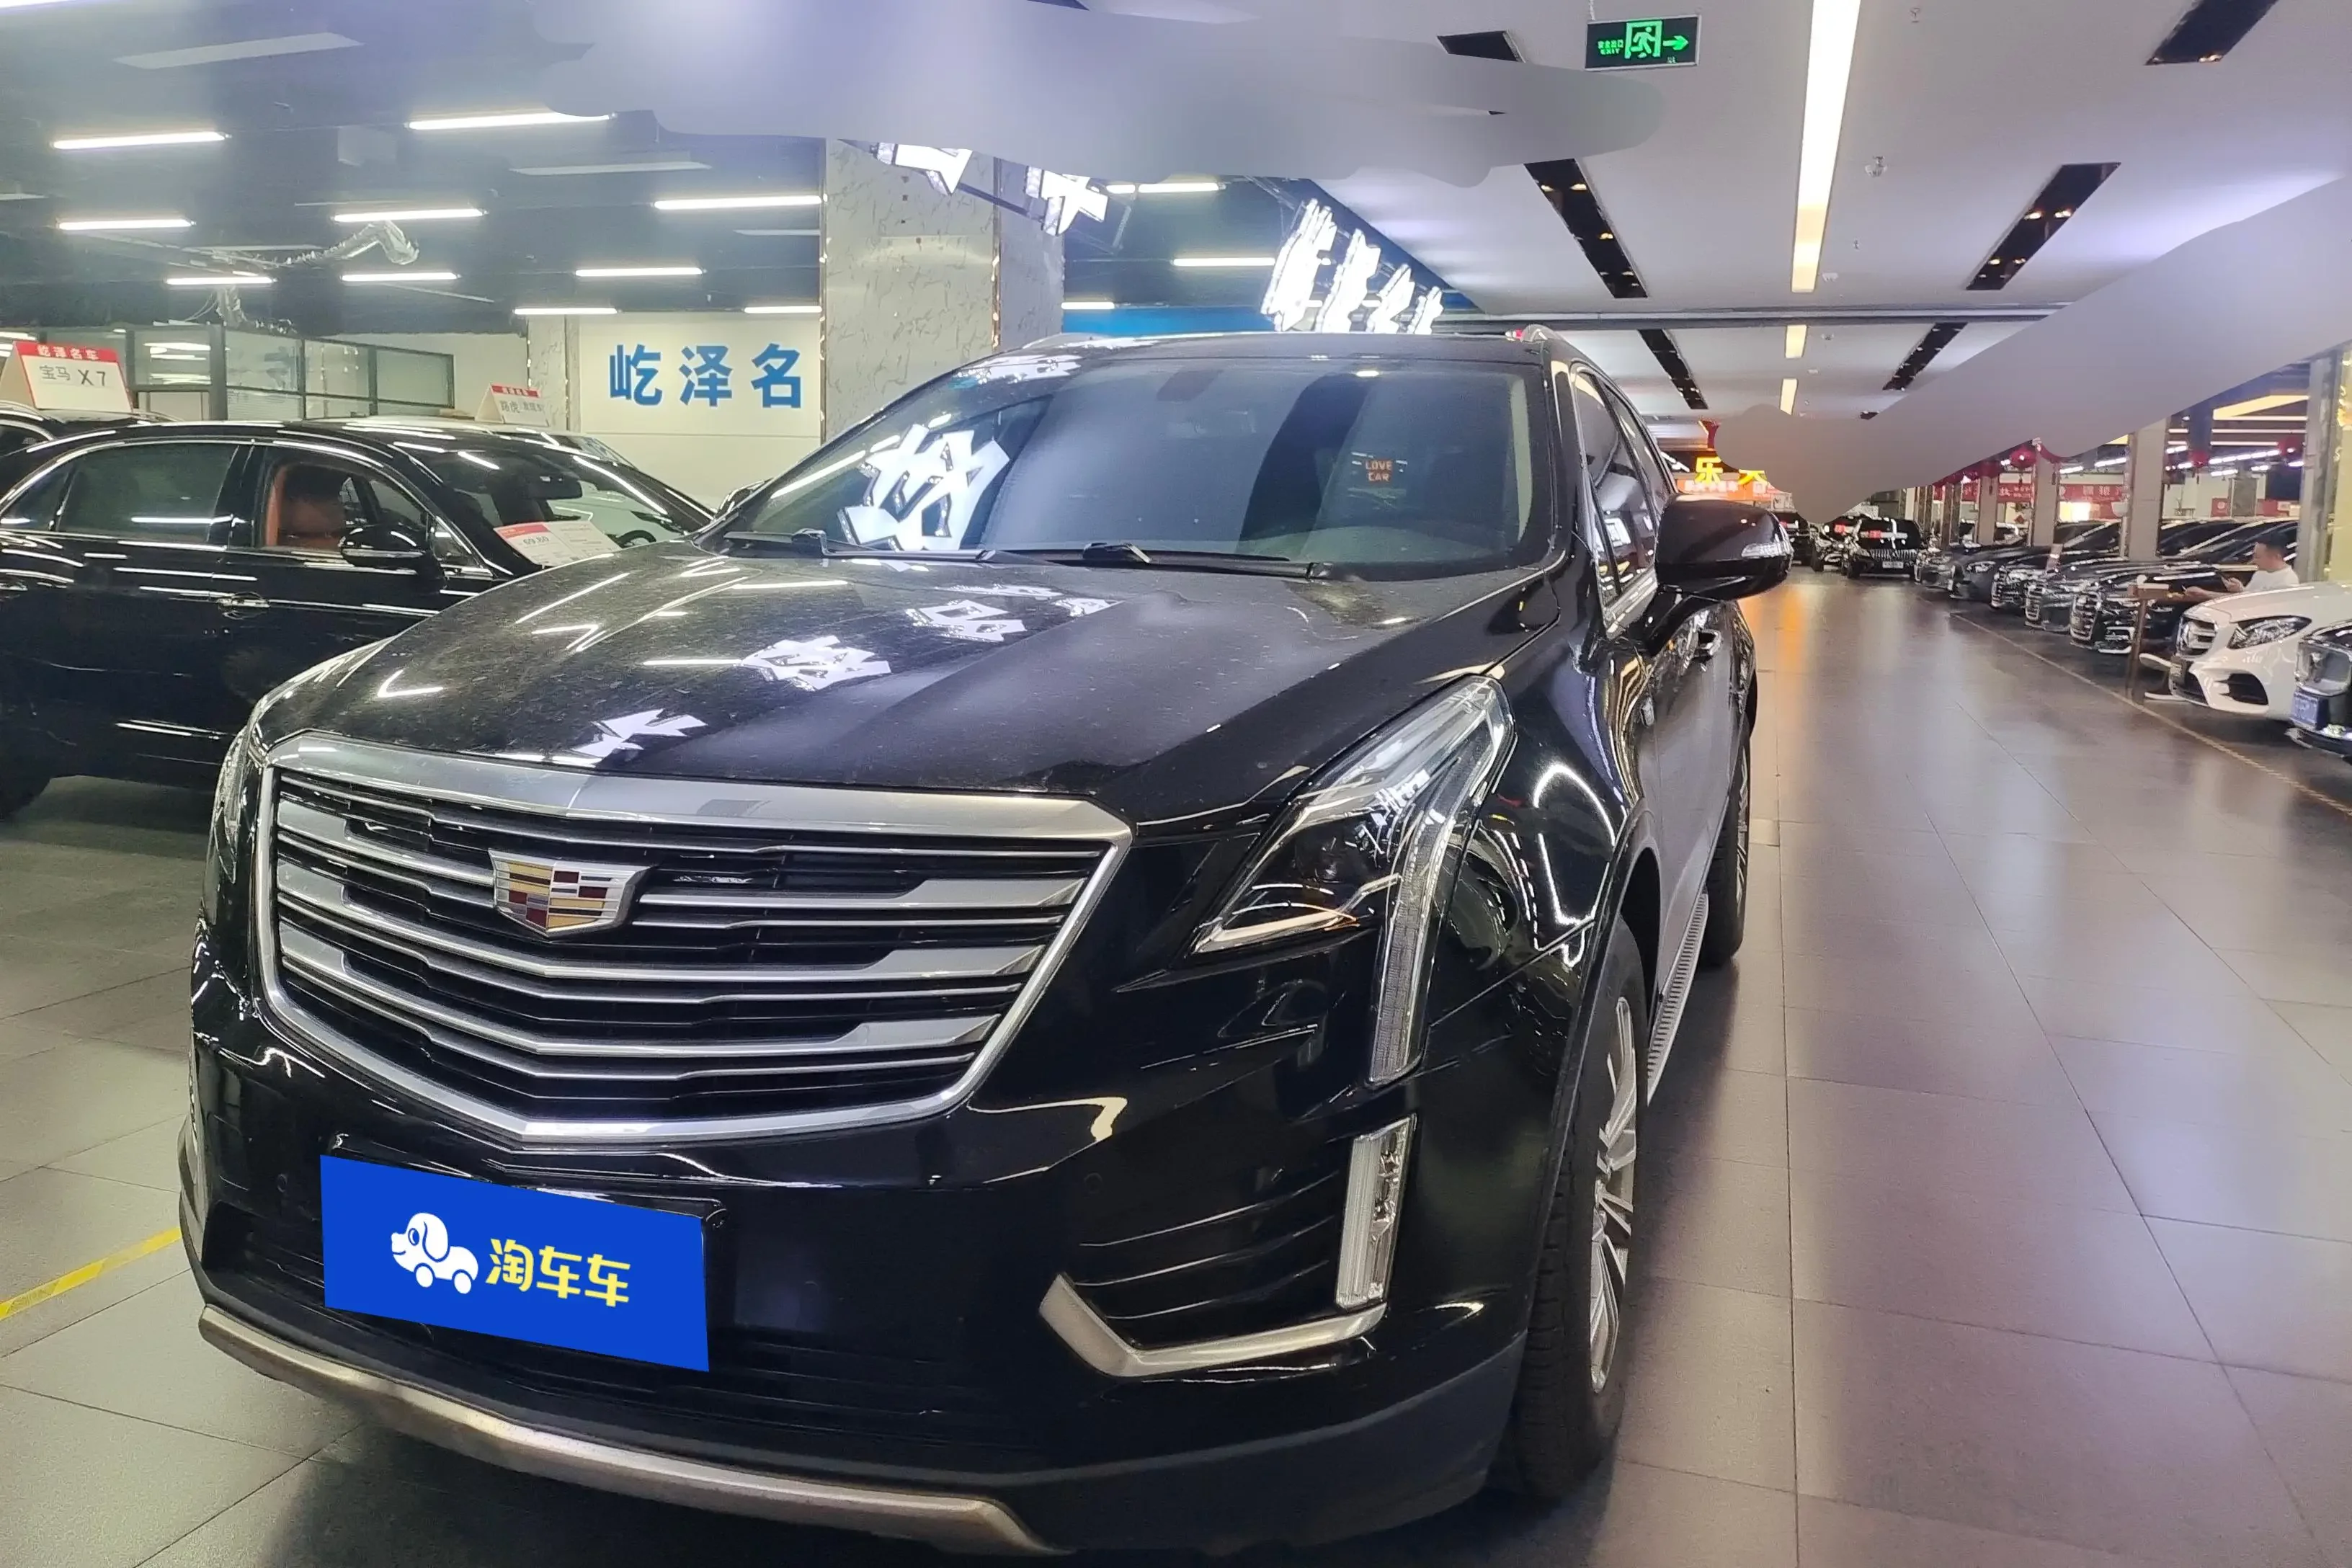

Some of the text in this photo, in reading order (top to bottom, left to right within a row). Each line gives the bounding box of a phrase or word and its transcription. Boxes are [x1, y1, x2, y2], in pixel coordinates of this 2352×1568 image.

[39, 365, 71, 380] 宝马
[610, 343, 801, 408] 屹泽名
[1366, 460, 1392, 470] LOVE
[1368, 472, 1389, 482] CAR
